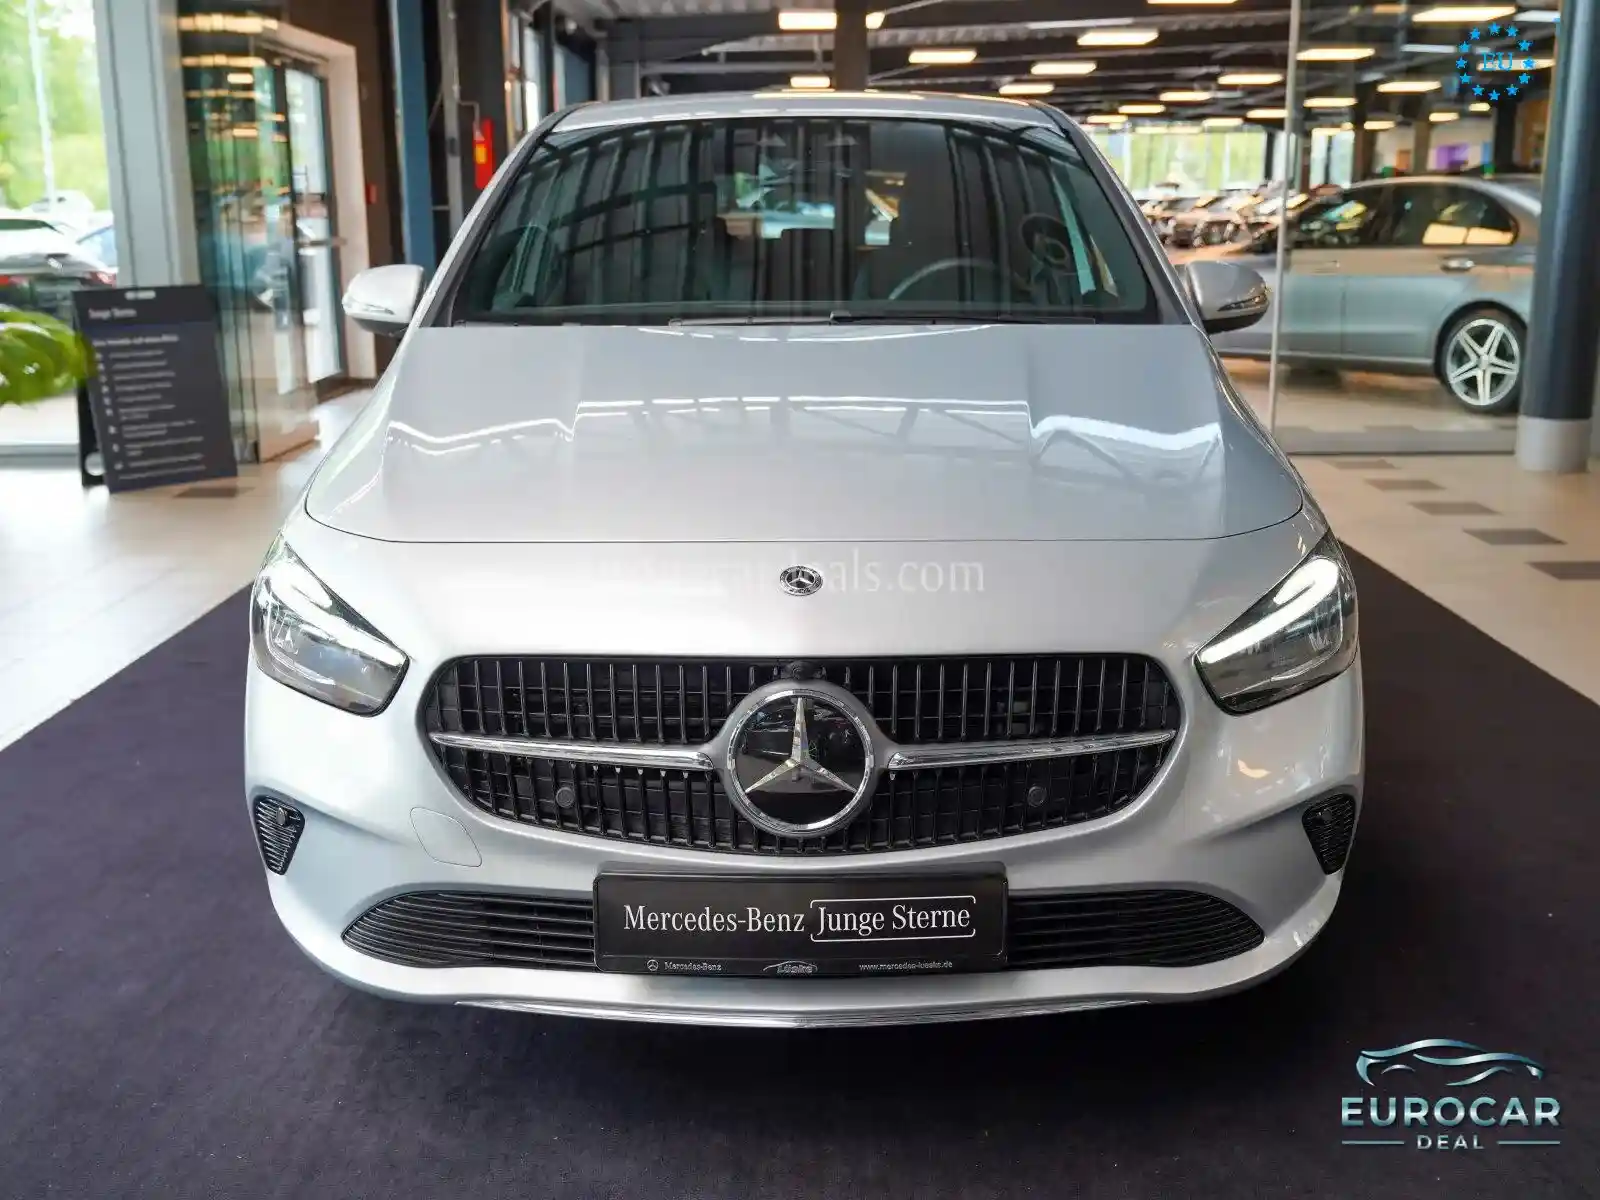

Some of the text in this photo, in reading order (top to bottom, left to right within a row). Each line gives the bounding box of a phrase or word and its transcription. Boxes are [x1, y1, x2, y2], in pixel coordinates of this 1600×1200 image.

[623, 904, 970, 937] Mercedes-Benz Junge Sterne
[664, 961, 722, 971] Mercedes-Benz
